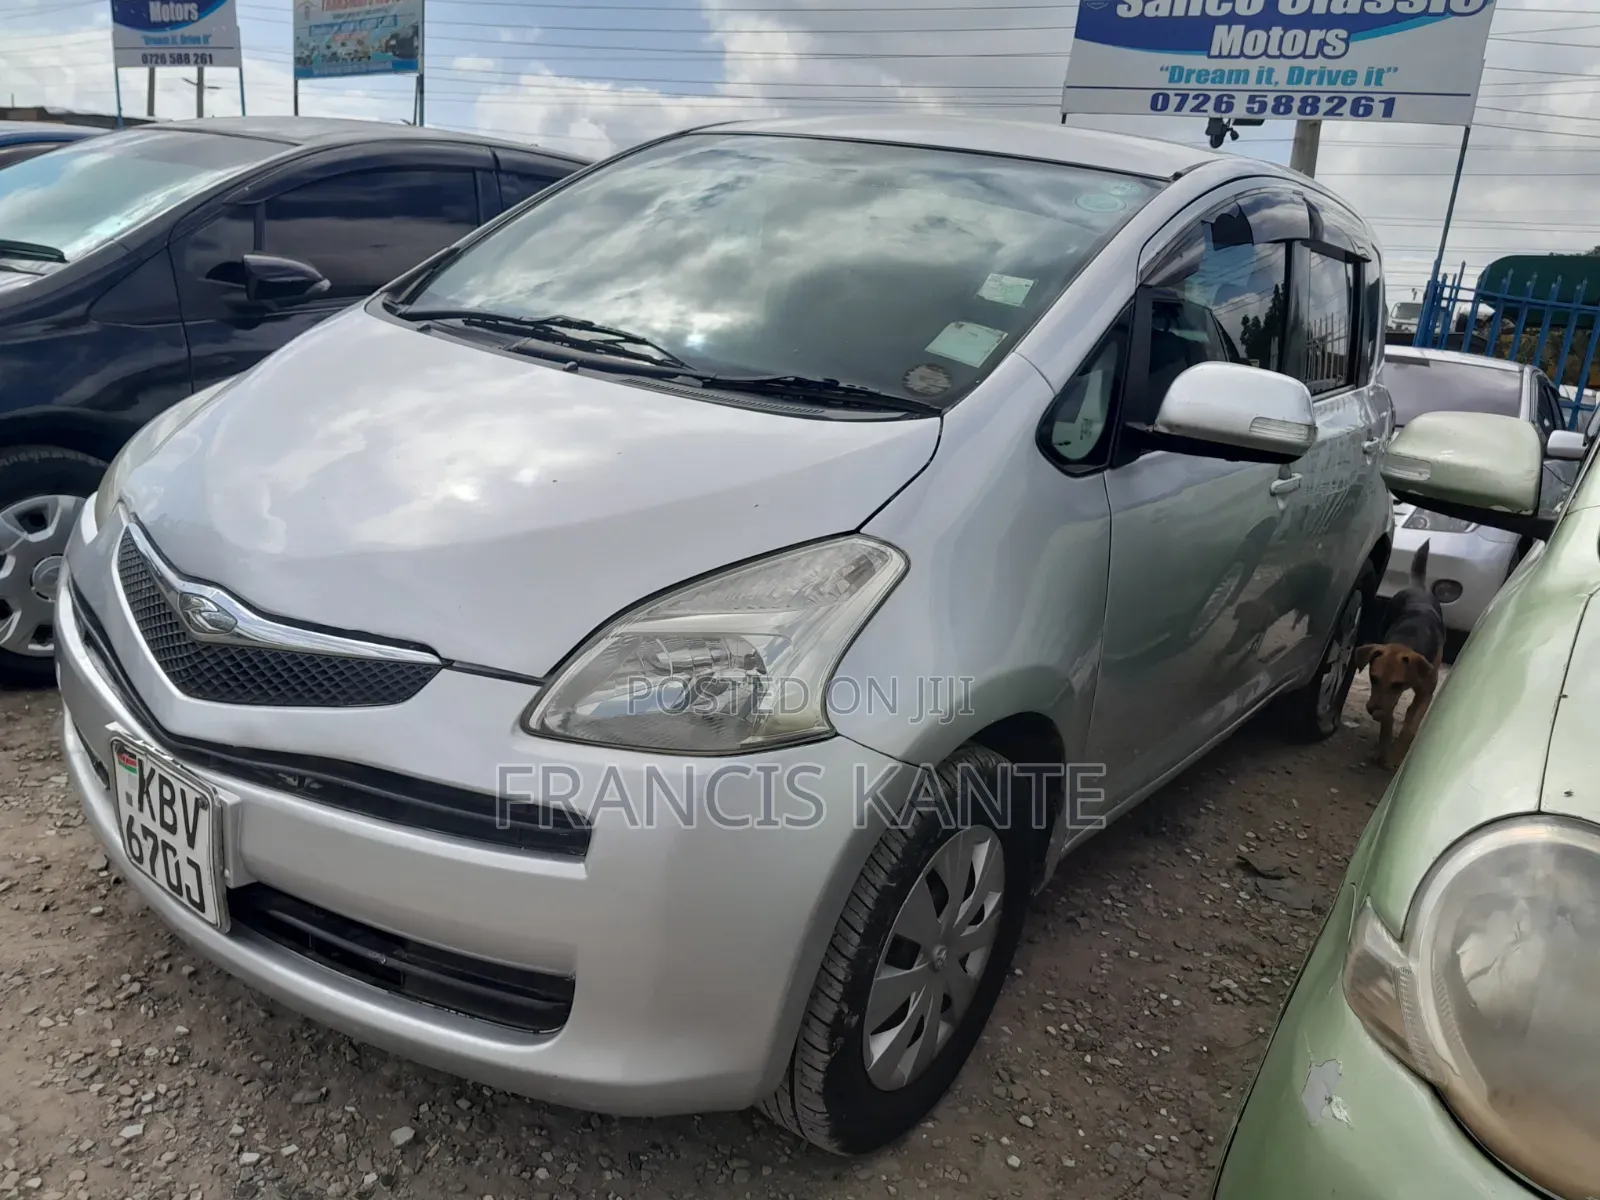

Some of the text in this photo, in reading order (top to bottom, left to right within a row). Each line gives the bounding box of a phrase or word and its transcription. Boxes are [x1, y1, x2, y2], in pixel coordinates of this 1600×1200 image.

[148, 0, 199, 23] Motors
[1209, 24, 1349, 58] Motors
[141, 53, 167, 65] 0726
[193, 53, 213, 65] 261
[1160, 65, 1250, 85] “Dream
[1255, 66, 1279, 87] it,
[1286, 66, 1358, 86] Drive
[1149, 92, 1397, 118] 0726 588261
[138, 758, 200, 850] KBV
